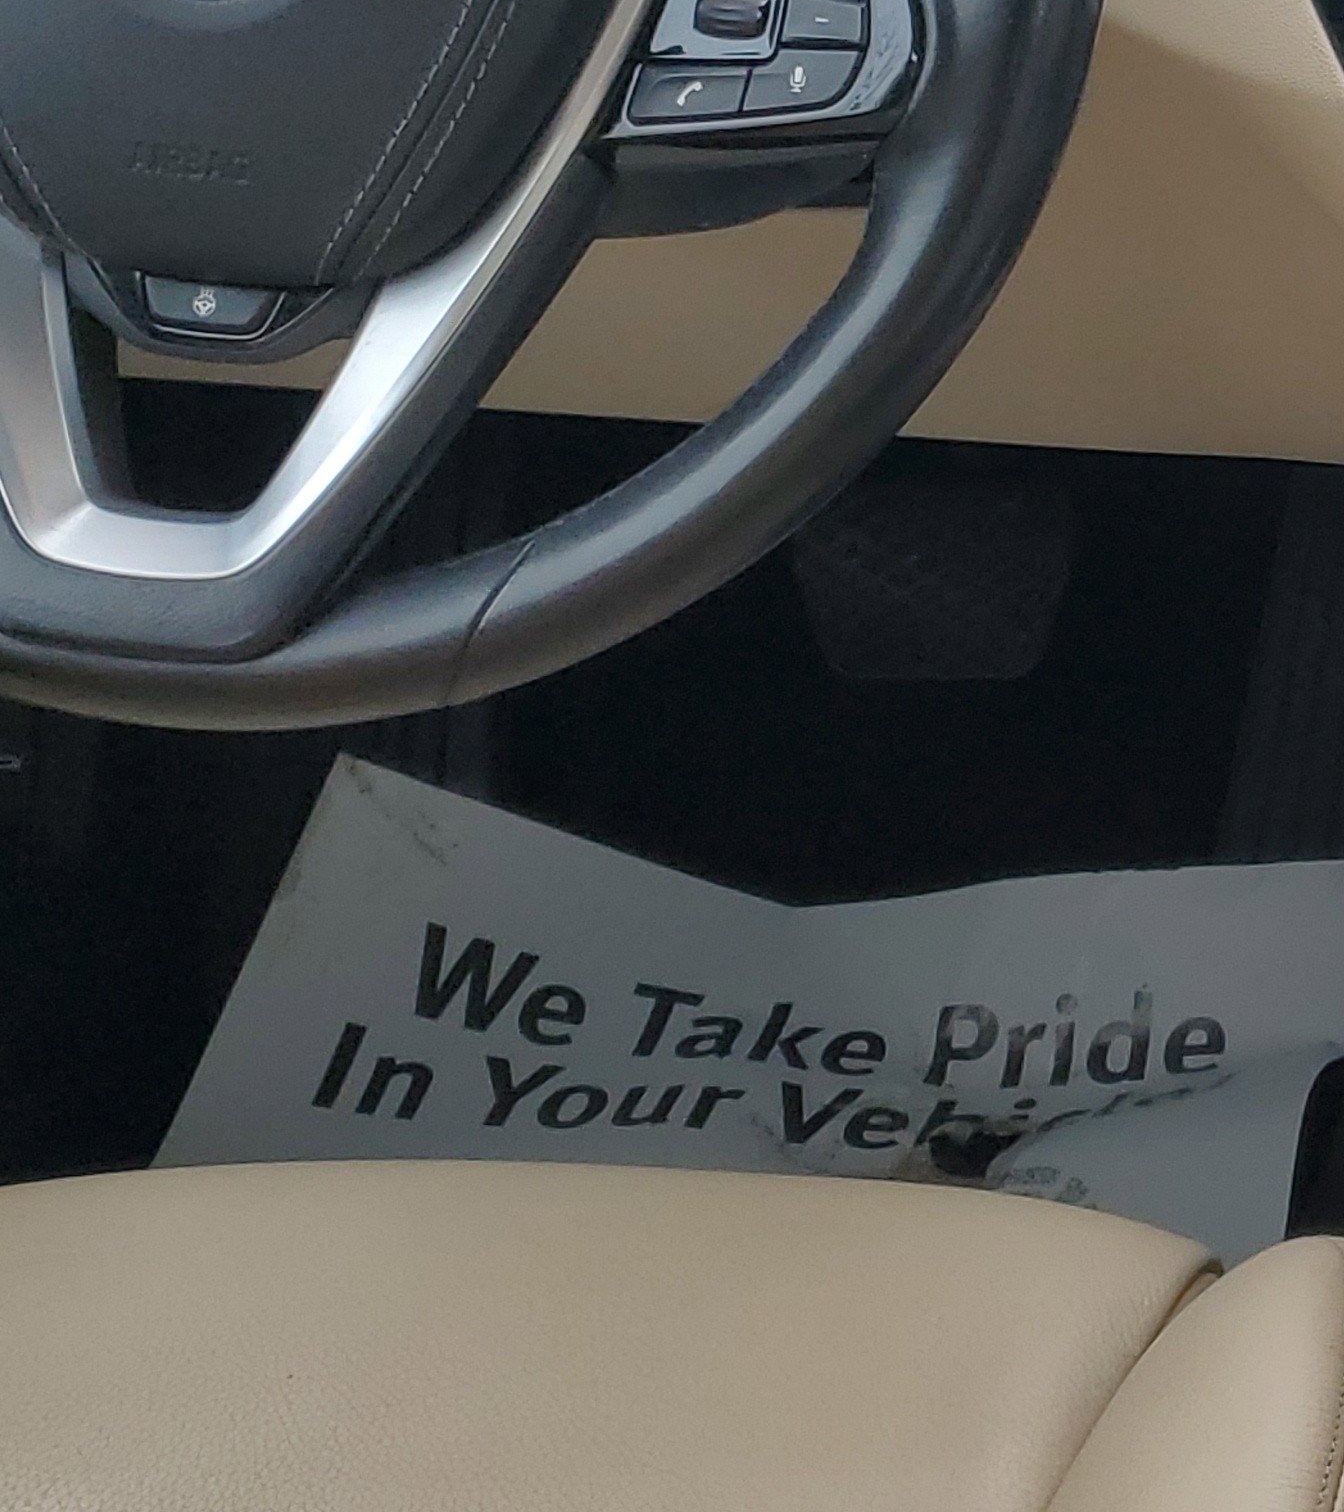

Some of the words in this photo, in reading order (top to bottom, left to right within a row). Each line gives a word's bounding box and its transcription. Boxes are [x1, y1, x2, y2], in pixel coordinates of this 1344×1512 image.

[414, 921, 587, 1046] We
[631, 981, 888, 1076] Take
[922, 982, 1228, 1088] Pride
[311, 1021, 435, 1120] In
[482, 1054, 746, 1129] Your
